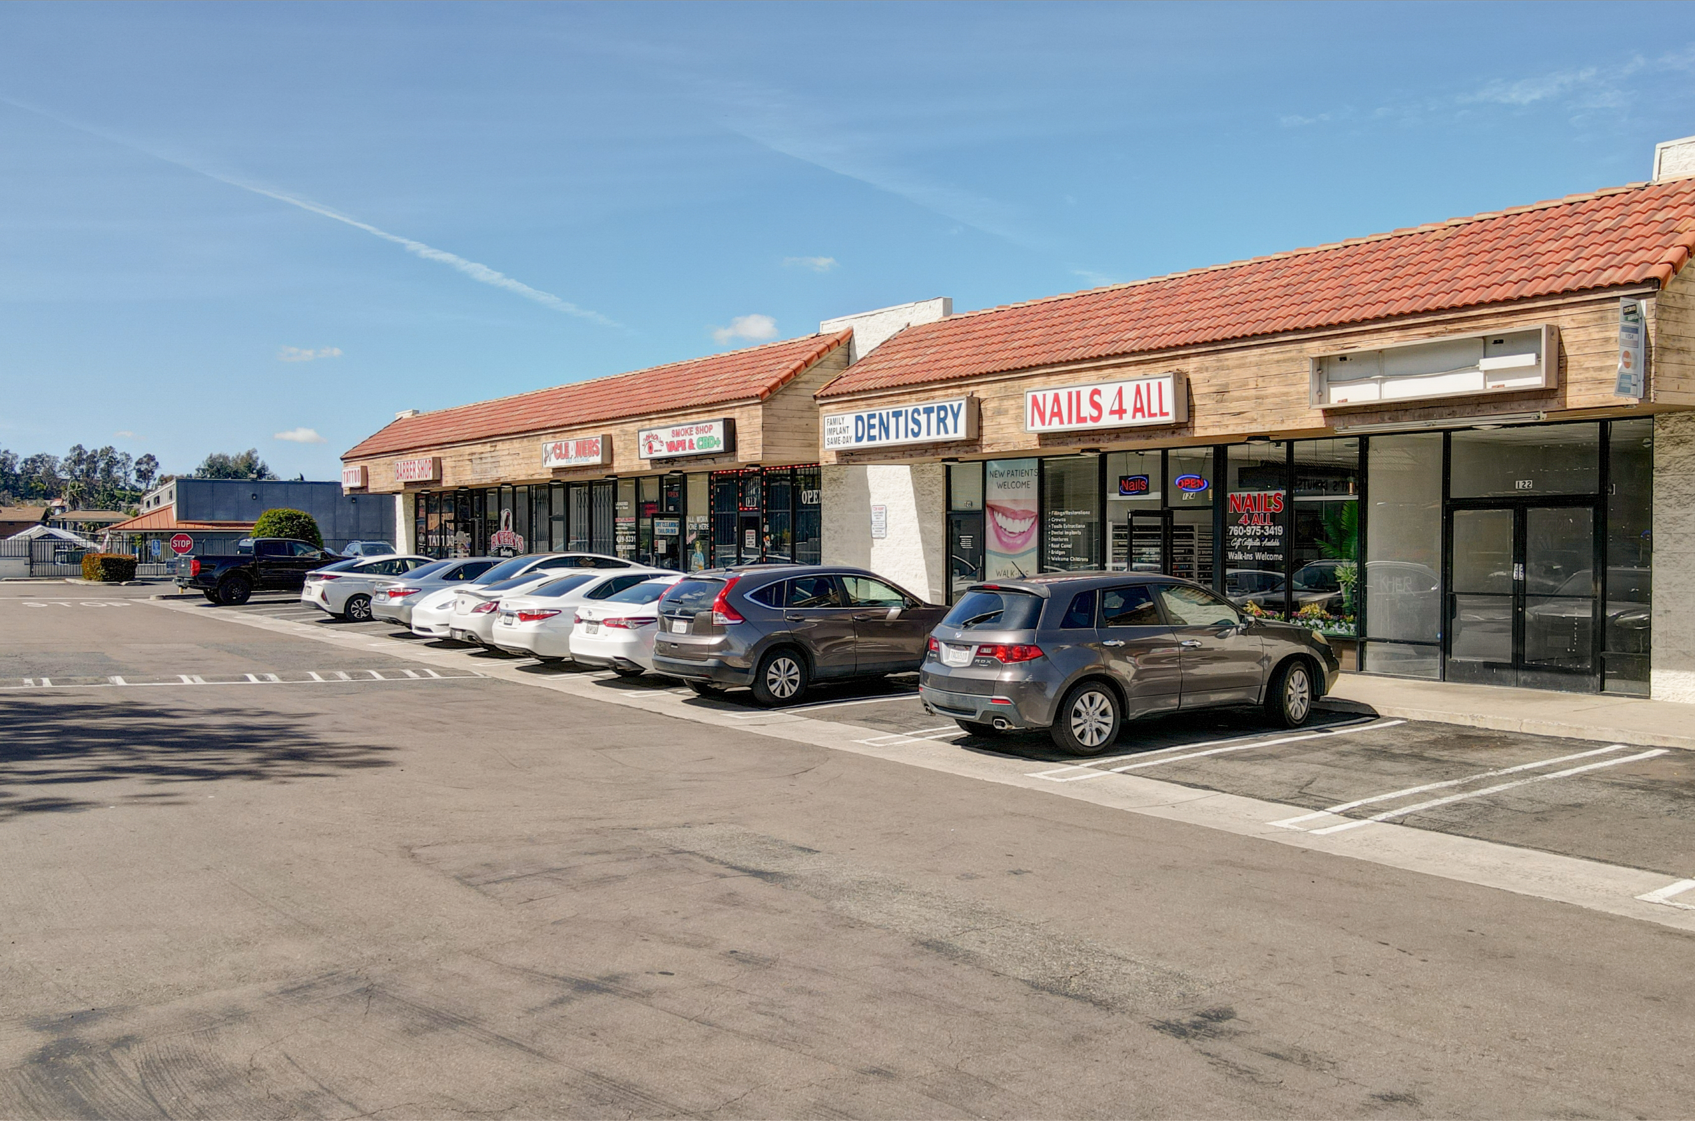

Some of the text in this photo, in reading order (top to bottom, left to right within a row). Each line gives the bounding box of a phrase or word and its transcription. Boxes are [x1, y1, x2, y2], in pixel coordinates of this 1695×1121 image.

[1030, 381, 1170, 427] NAILS 4 ALL
[826, 416, 845, 426] FAMILY
[854, 402, 963, 443] DENTISTRY
[671, 424, 713, 438] SMOKE SHOP
[826, 425, 850, 436] IMPLANT
[665, 439, 687, 453] VAPE
[688, 438, 696, 450] &
[826, 435, 853, 446] SAME-DAY
[553, 438, 600, 460] CLEANERS
[396, 459, 432, 480] BARBER SHOP
[989, 468, 1038, 478] NEW PATIENTS
[343, 469, 360, 484] TATTOO
[996, 480, 1031, 489] WELCOME
[1121, 479, 1147, 491] Nails
[1177, 478, 1204, 489] OPEN
[1516, 480, 1532, 489] 122
[1229, 492, 1284, 513] NAILS
[1238, 513, 1273, 525] 4 ALL
[1228, 525, 1283, 536] 760-975-3419
[172, 540, 191, 548] STOP
[1227, 551, 1283, 561] Walk-Ins Welcome
